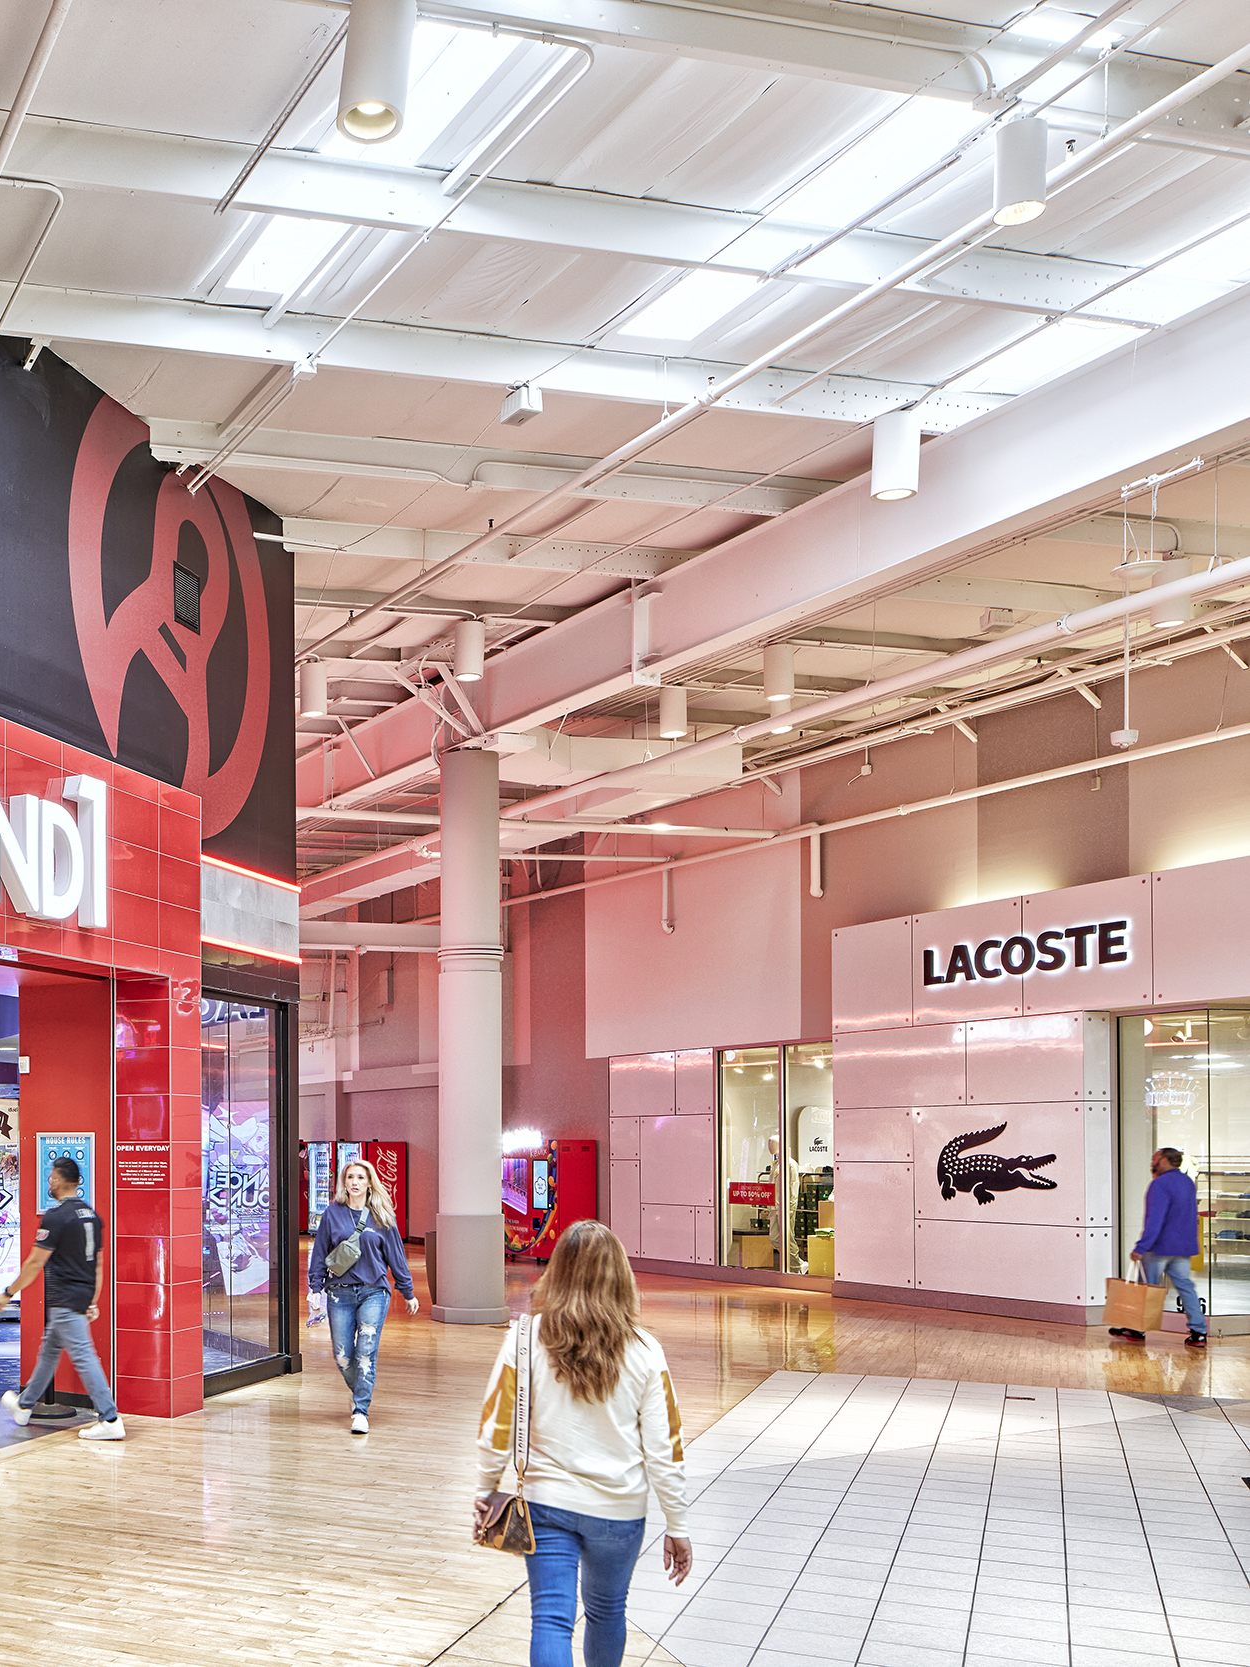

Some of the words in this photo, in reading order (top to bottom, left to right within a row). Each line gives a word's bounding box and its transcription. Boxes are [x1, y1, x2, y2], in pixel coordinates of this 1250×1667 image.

[923, 920, 1128, 986] LACOSTE
[45, 1136, 65, 1144] HOUSE
[66, 1136, 86, 1144] RULES
[1176, 1295, 1207, 1315] 96
